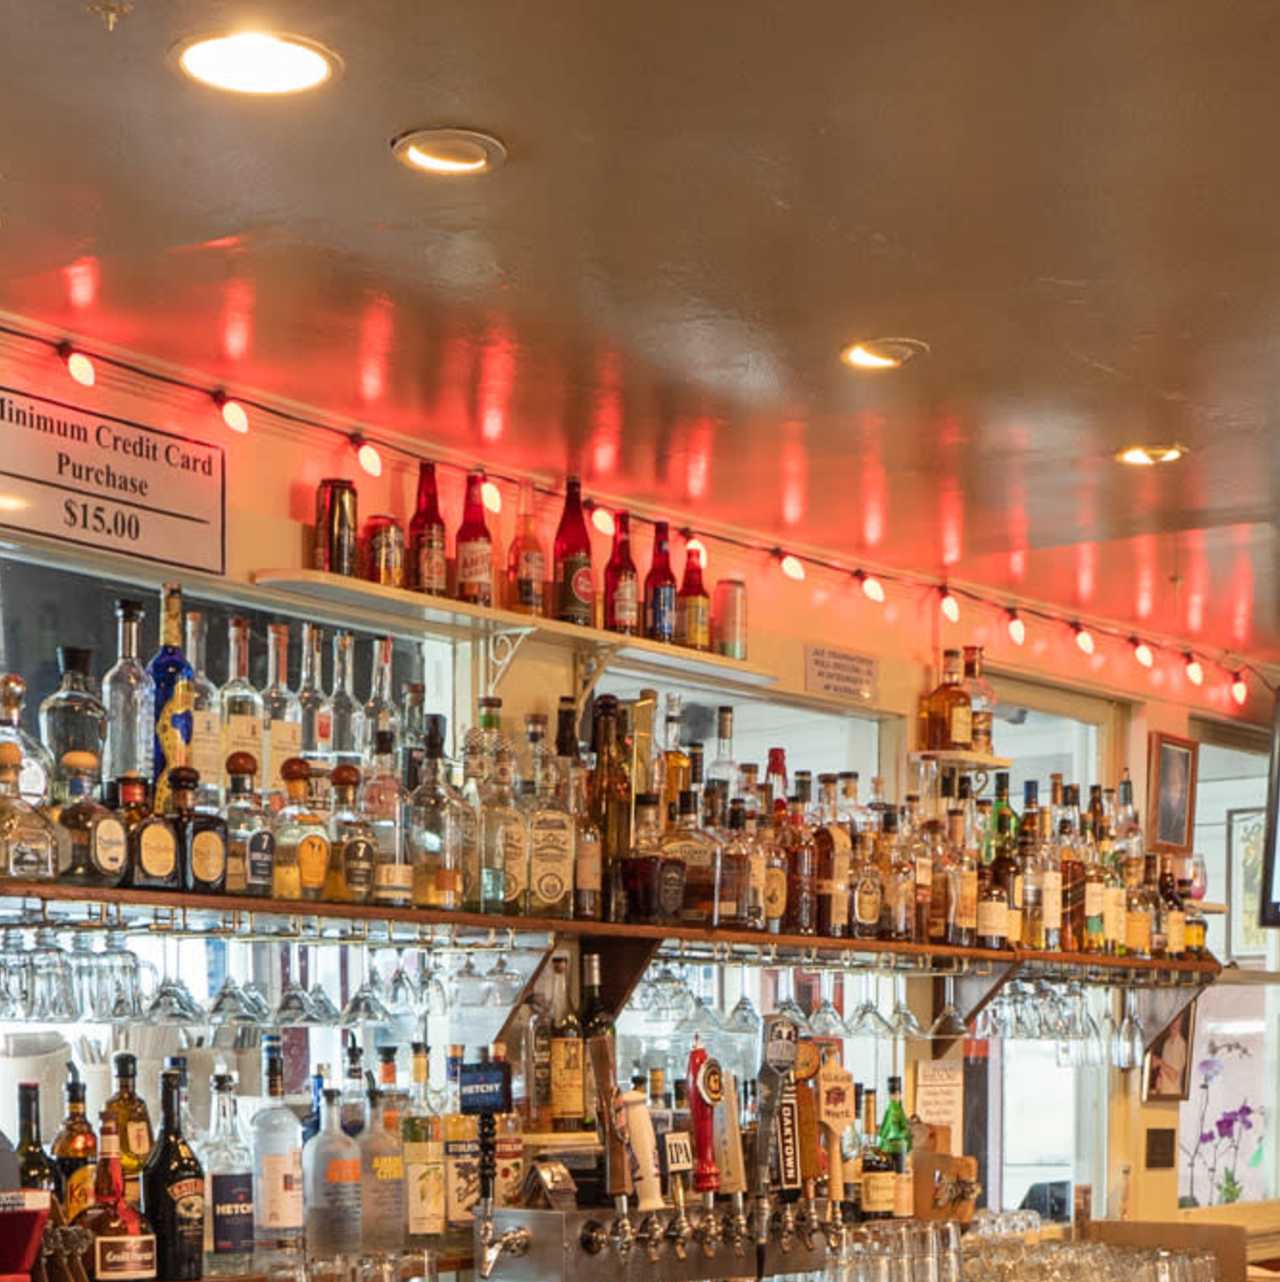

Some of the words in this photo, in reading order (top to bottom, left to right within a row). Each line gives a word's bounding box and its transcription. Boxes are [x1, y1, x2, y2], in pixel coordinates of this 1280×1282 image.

[95, 425, 158, 462] Credit
[164, 444, 213, 477] Card
[57, 452, 148, 497] Purchase
[64, 498, 140, 541] $15.00
[668, 1138, 692, 1165] IPA
[781, 1105, 796, 1181] OAKTOWN
